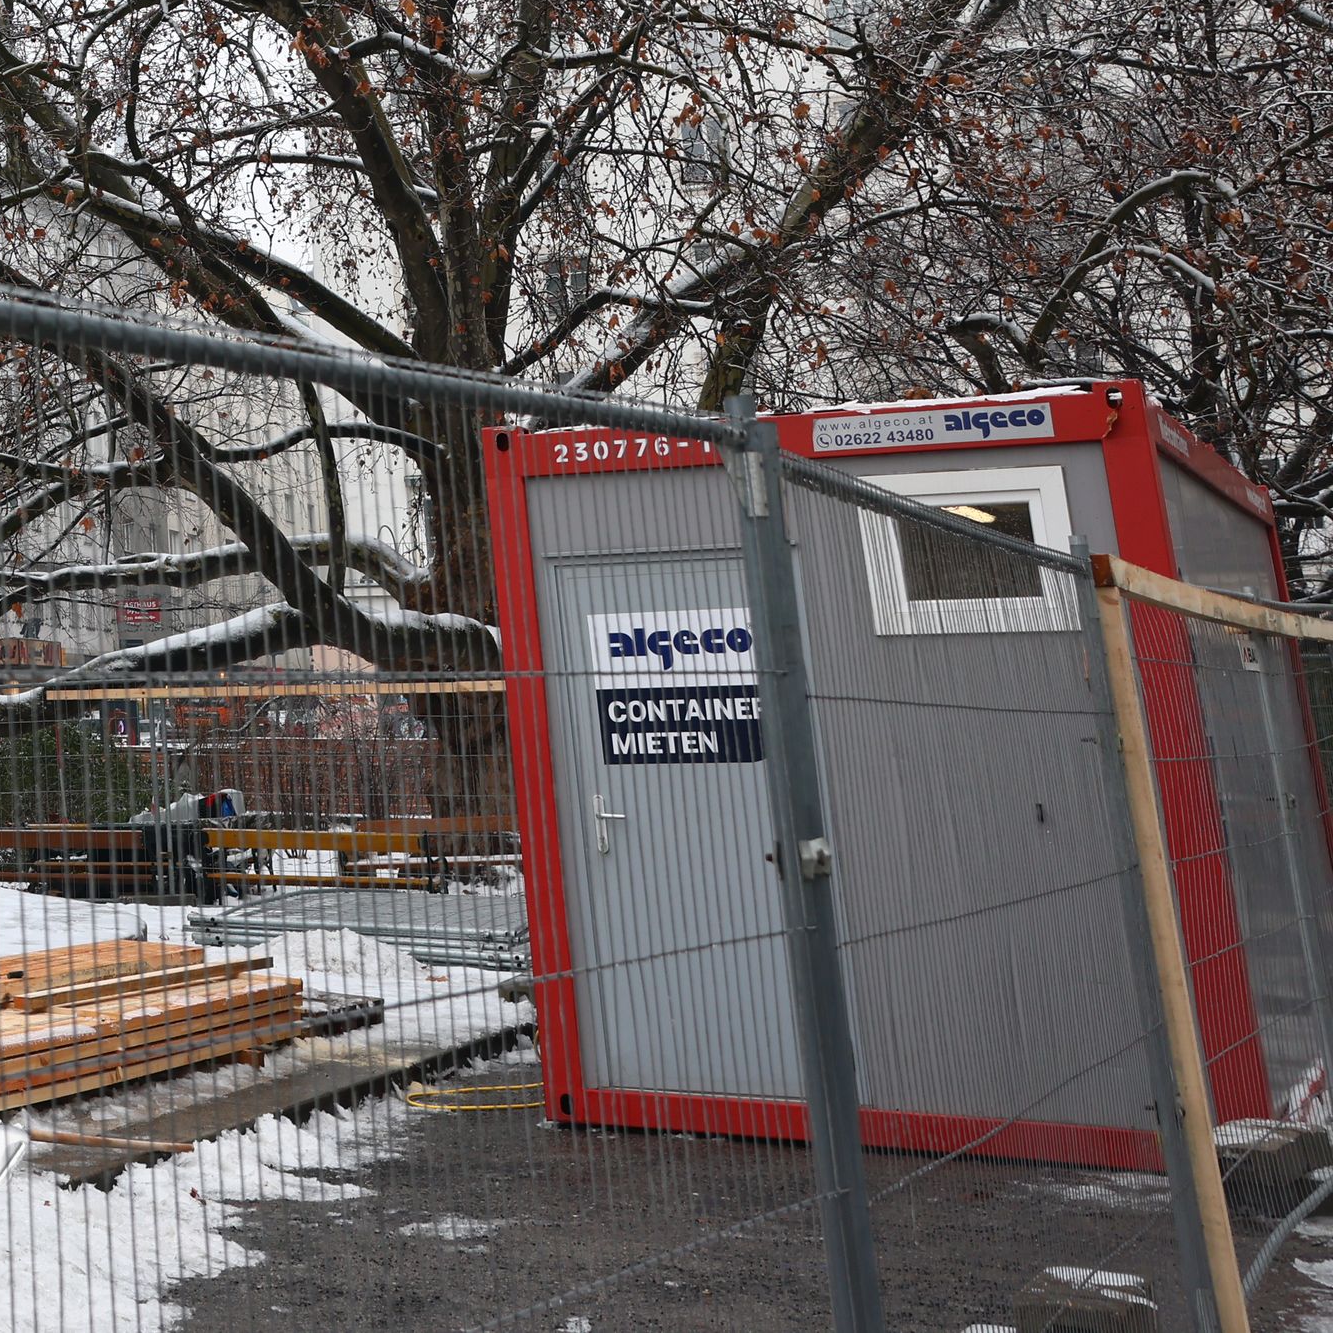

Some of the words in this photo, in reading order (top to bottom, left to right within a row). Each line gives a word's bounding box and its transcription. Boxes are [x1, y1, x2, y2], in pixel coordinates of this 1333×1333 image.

[818, 414, 933, 432] www.algeco.at
[944, 408, 1045, 439] algeco
[834, 432, 882, 447] 02622
[886, 428, 934, 443] 43480
[120, 601, 157, 609] ASTHAUS
[608, 628, 753, 671] algeco
[611, 730, 719, 755] MIETEN
